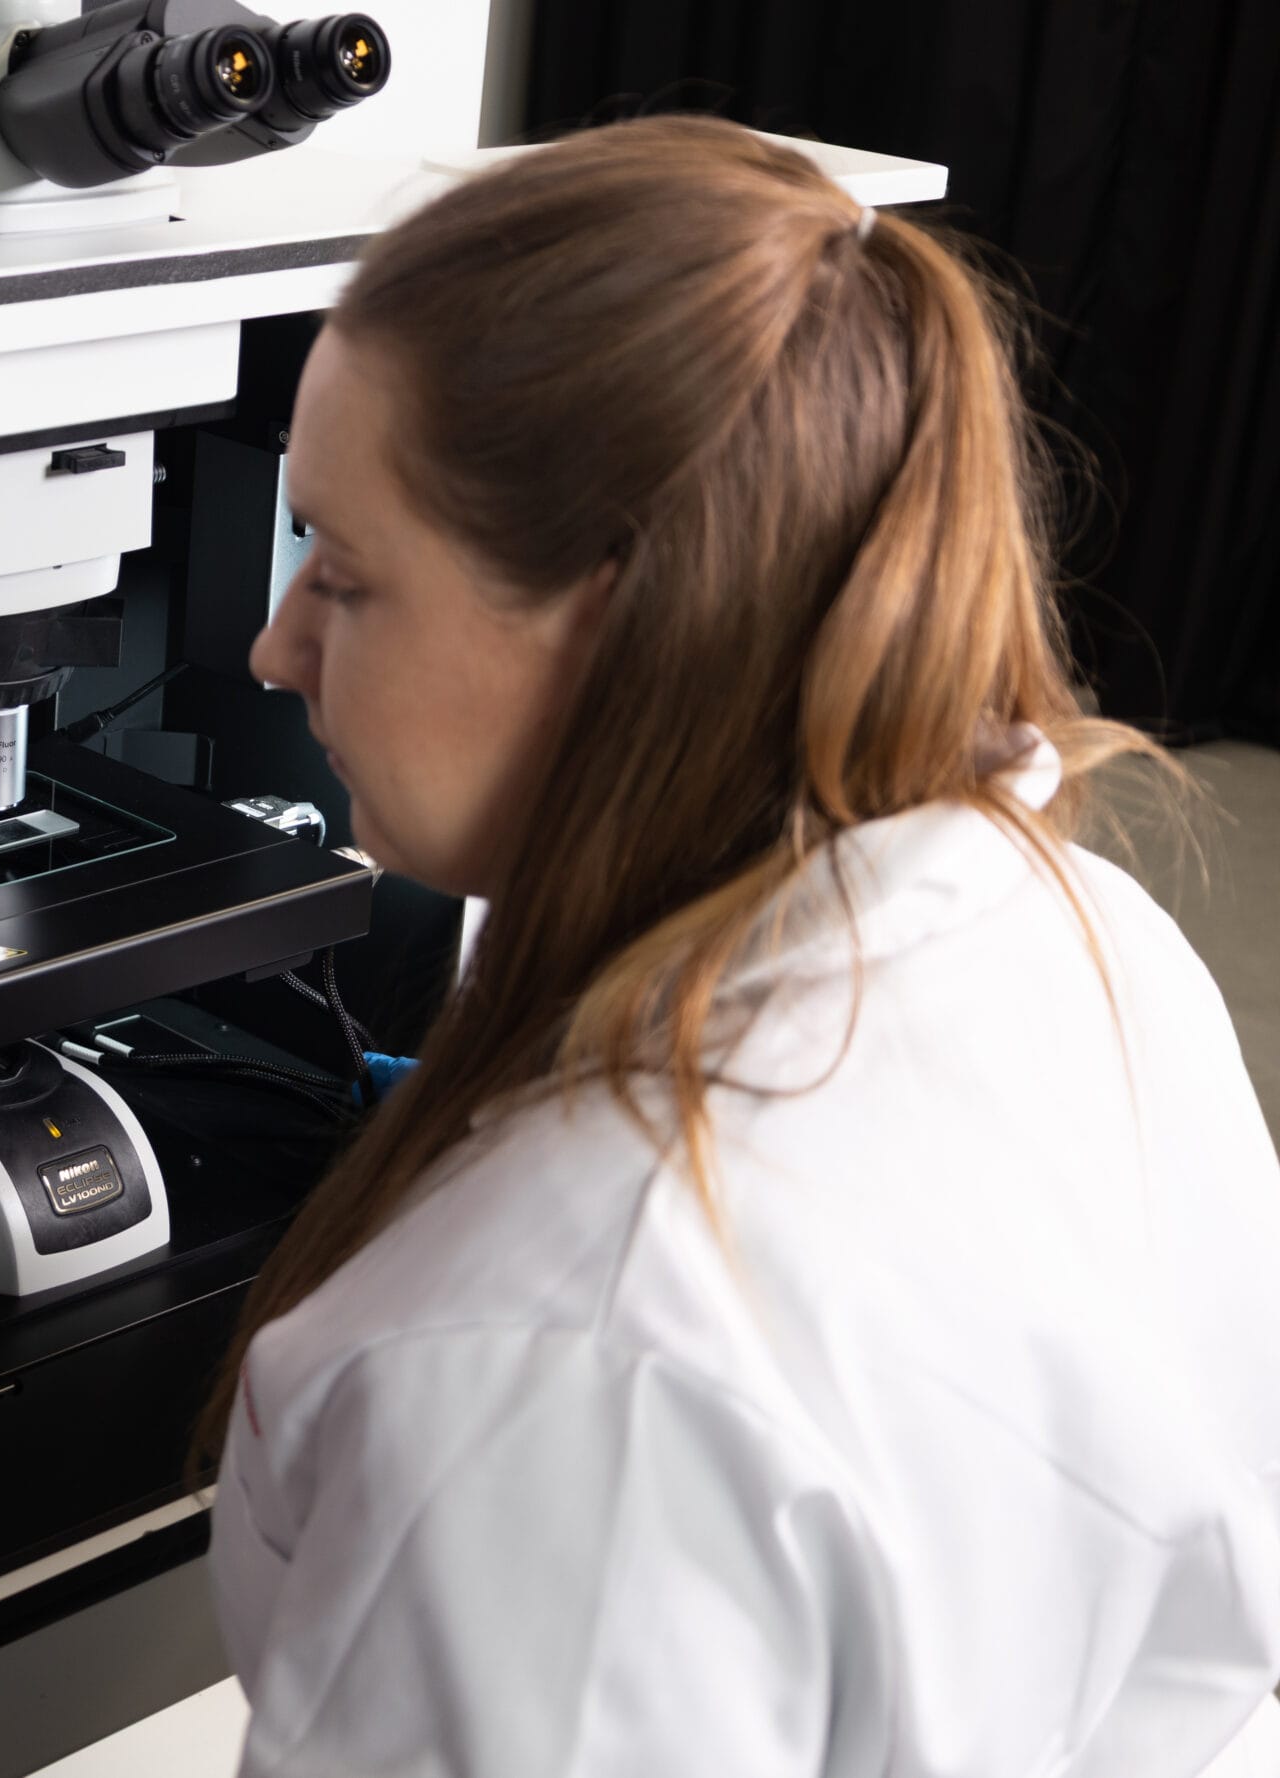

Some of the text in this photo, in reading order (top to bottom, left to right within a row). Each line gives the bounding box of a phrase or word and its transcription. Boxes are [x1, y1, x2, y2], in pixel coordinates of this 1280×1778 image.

[57, 1171, 111, 1195] ECLIPSE
[58, 1160, 99, 1182] Nikon
[61, 1182, 114, 1206] LV100ND
